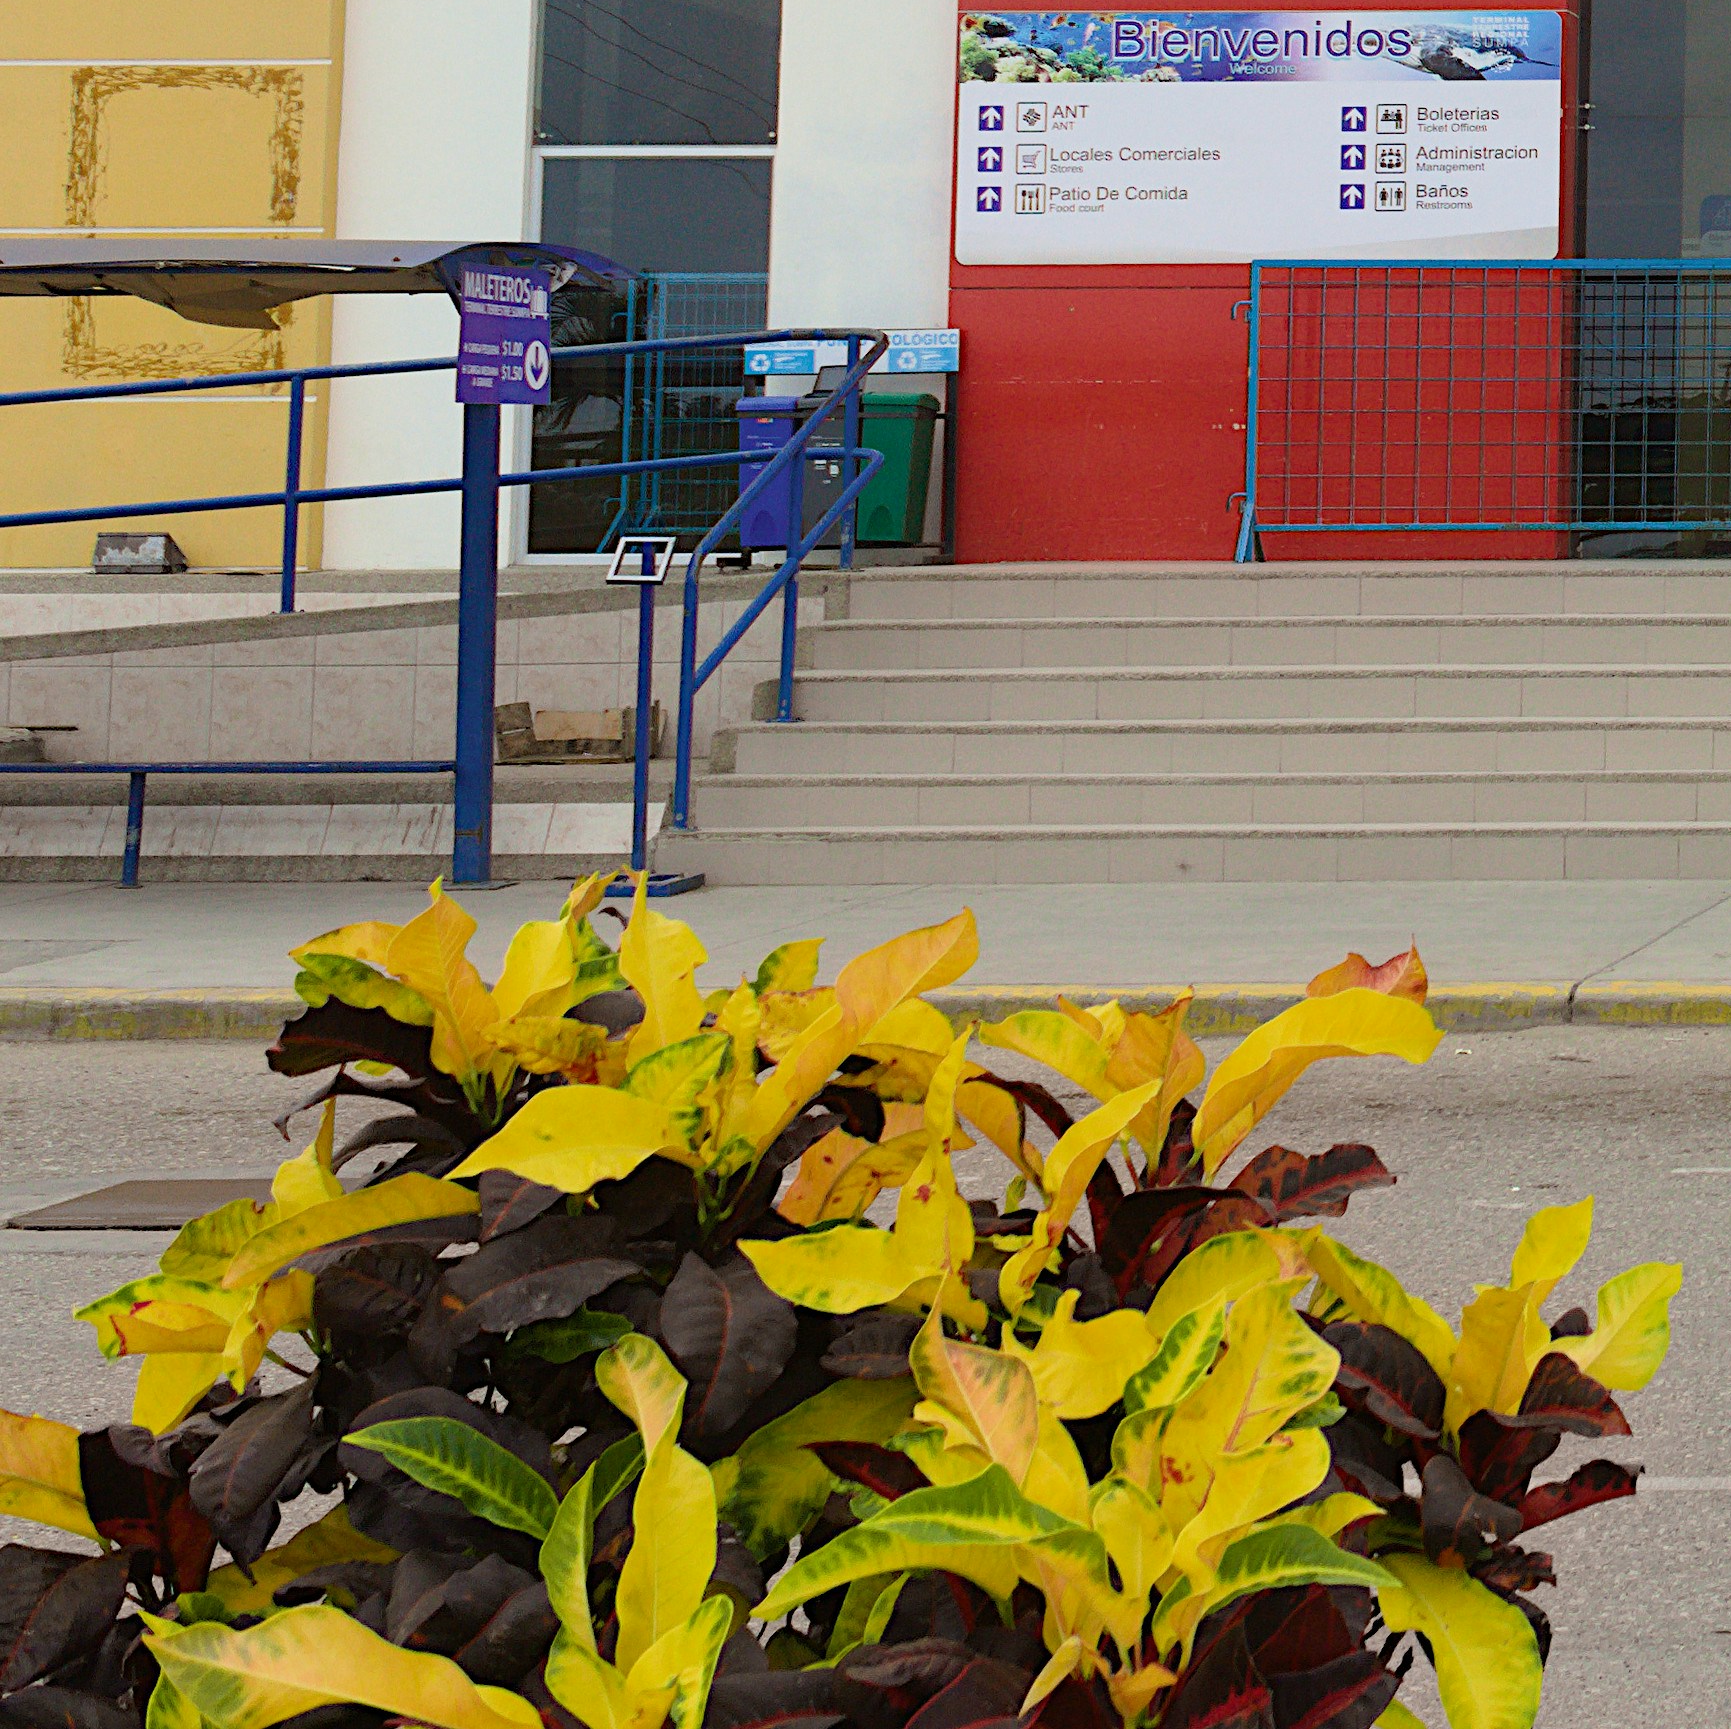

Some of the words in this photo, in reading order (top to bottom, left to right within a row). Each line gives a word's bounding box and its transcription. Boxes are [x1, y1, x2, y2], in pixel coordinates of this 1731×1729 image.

[1112, 19, 1413, 59] Bienvenidos
[1228, 61, 1297, 76] Welcome
[1052, 104, 1090, 120] ANT
[1051, 122, 1075, 131] ANT
[1418, 123, 1448, 133] Ticket
[1451, 123, 1488, 133] Offices
[1050, 147, 1114, 162] Locales
[1119, 146, 1222, 162] Comerciales
[1416, 145, 1539, 160] Administracion
[1050, 163, 1084, 174] Stores
[1416, 162, 1485, 174] Management
[1049, 186, 1092, 201] Patio
[1096, 186, 1119, 201] De
[1125, 185, 1189, 201] Comida
[1416, 183, 1469, 199] Baños
[1049, 203, 1076, 213] Food
[1078, 203, 1105, 213] court
[1416, 199, 1473, 210] Restrooms
[464, 270, 532, 304] MALETEROS
